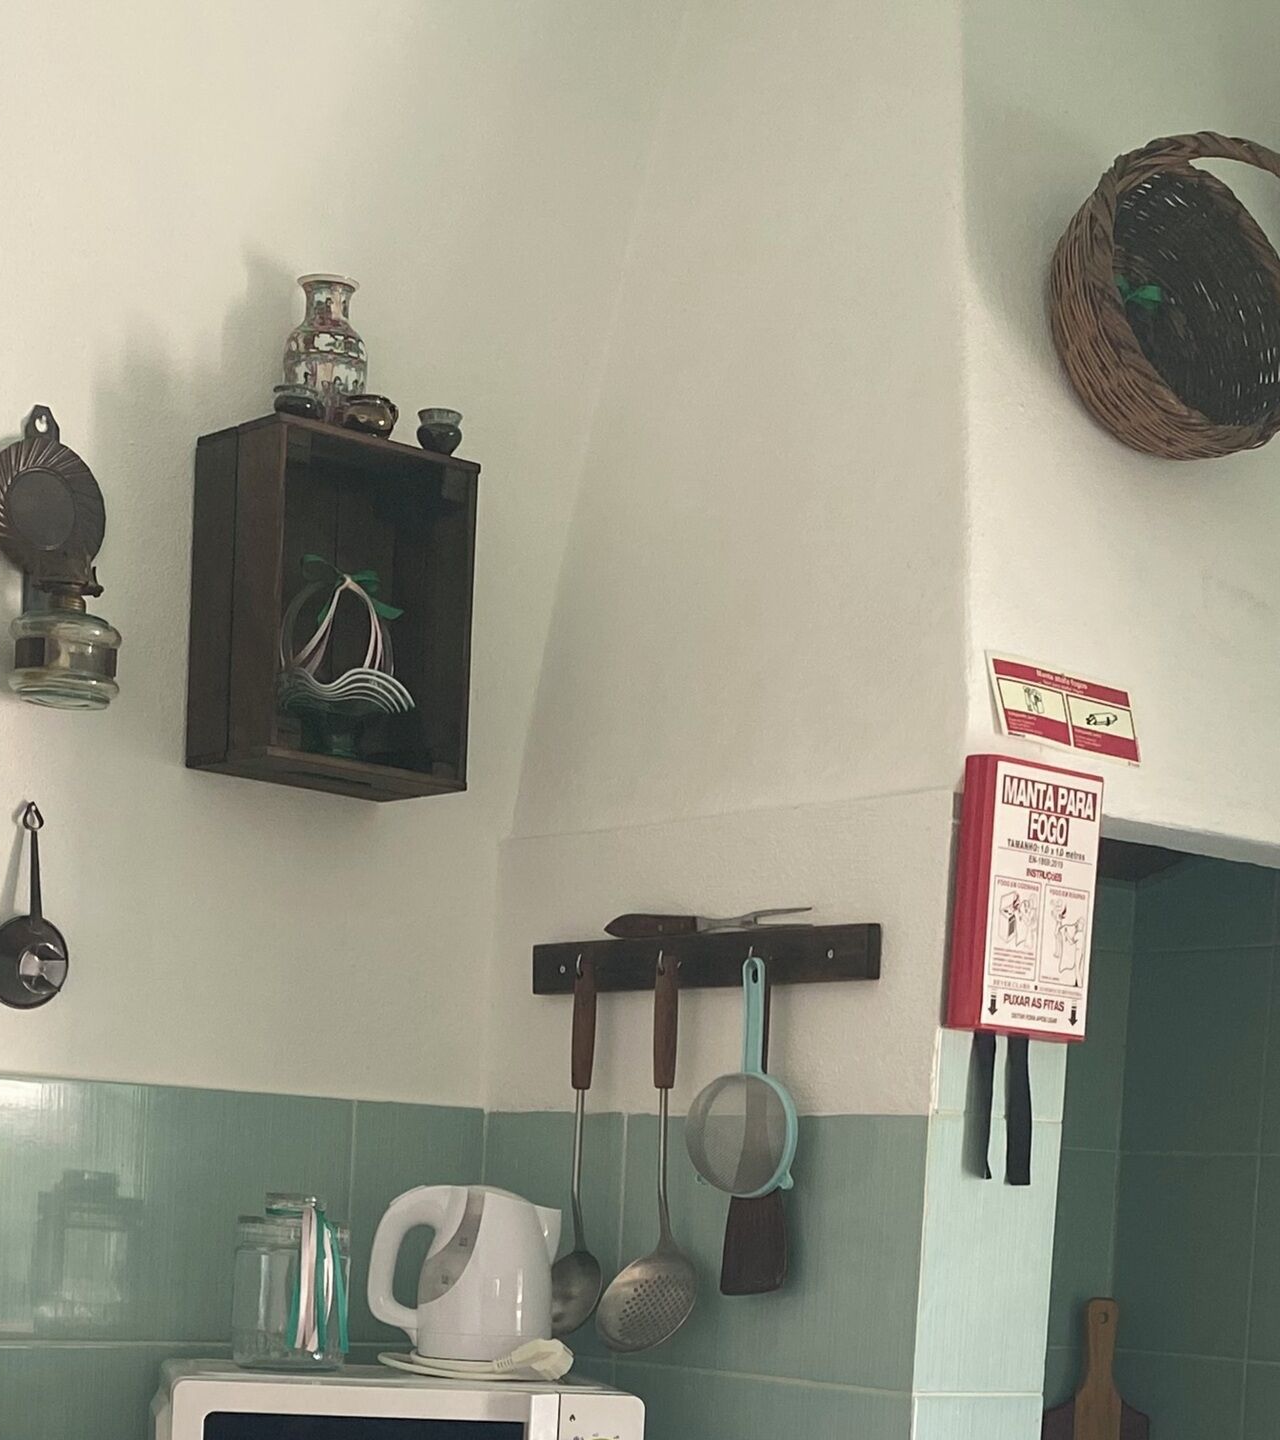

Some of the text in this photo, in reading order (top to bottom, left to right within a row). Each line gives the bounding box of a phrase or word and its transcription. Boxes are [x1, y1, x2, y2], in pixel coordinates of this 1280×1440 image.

[1003, 776, 1095, 821] MANTA PARA
[1029, 812, 1067, 845] FOGO
[1007, 838, 1040, 853] TAMANHO:
[1065, 851, 1086, 861] metros
[1003, 993, 1065, 1012] PUXAR AS FITAS
